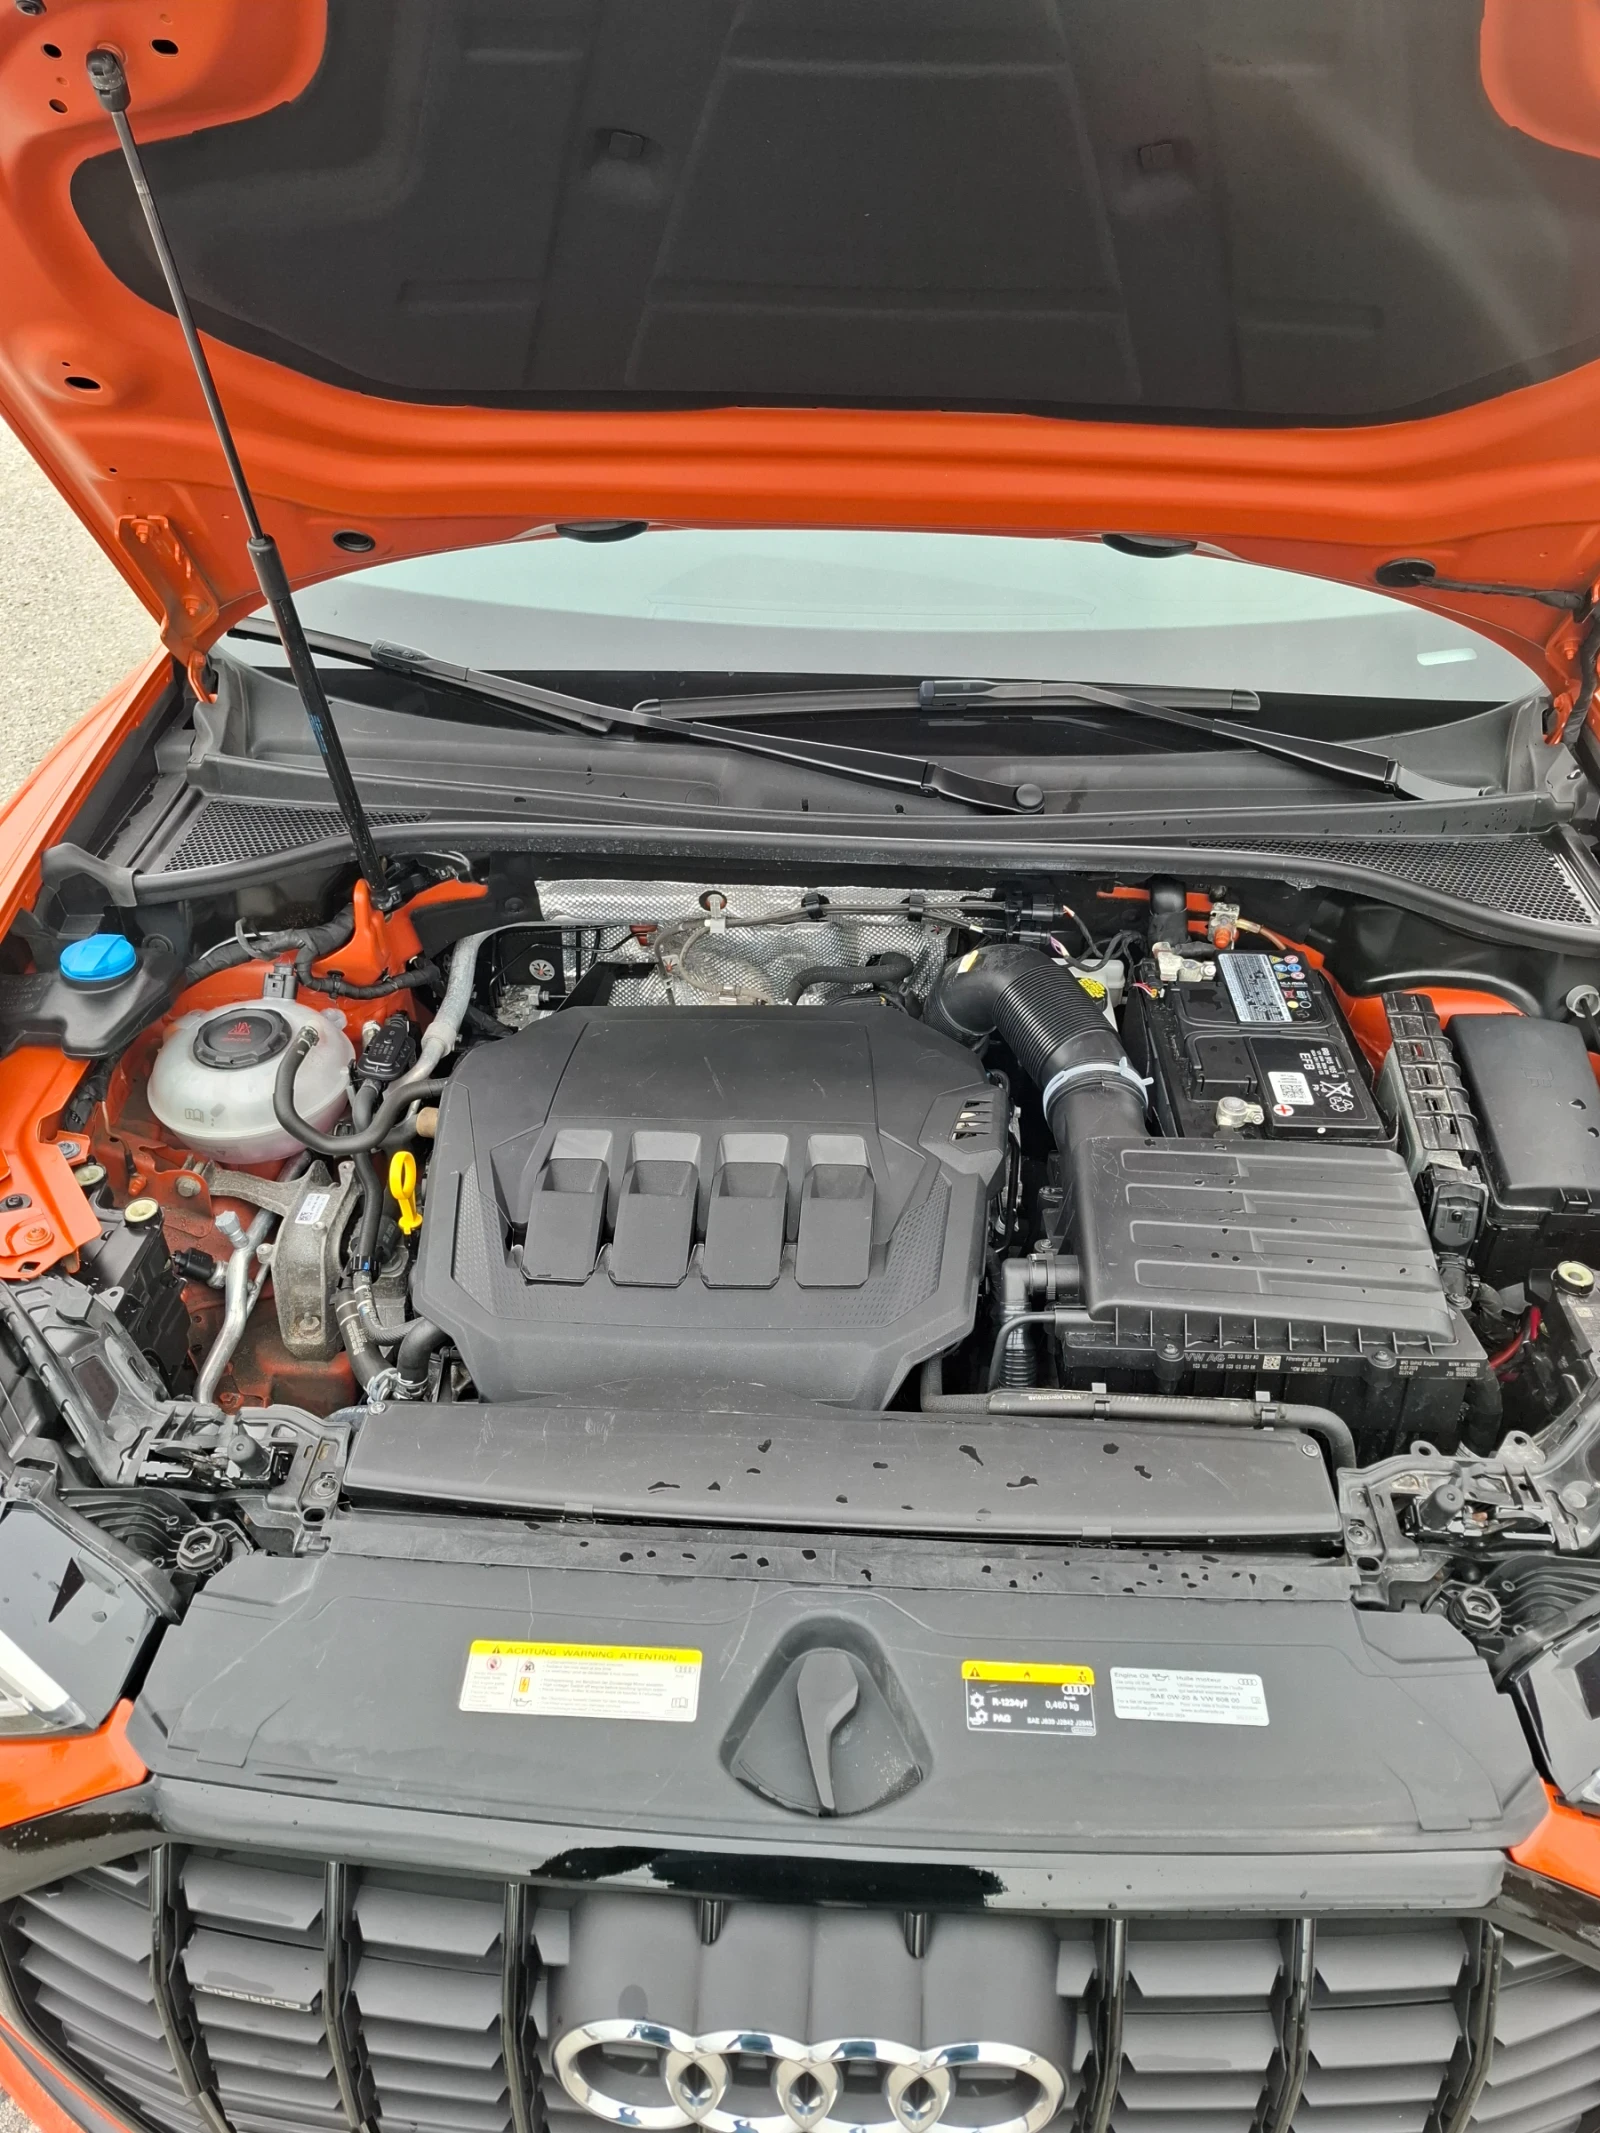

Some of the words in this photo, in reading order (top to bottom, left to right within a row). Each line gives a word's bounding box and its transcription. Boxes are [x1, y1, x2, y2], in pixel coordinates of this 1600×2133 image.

[1299, 1052, 1315, 1070] EFB
[1184, 1352, 1205, 1362] VW
[1206, 1353, 1225, 1362] AG
[506, 1647, 556, 1656] ACHTUNG
[562, 1649, 615, 1660] WARNING
[619, 1651, 677, 1662] ATTENTION
[1114, 1672, 1137, 1680] Engine
[992, 1698, 1028, 1708] R-1234yf
[1069, 1702, 1080, 1712] kg
[993, 1713, 1012, 1723] PAG
